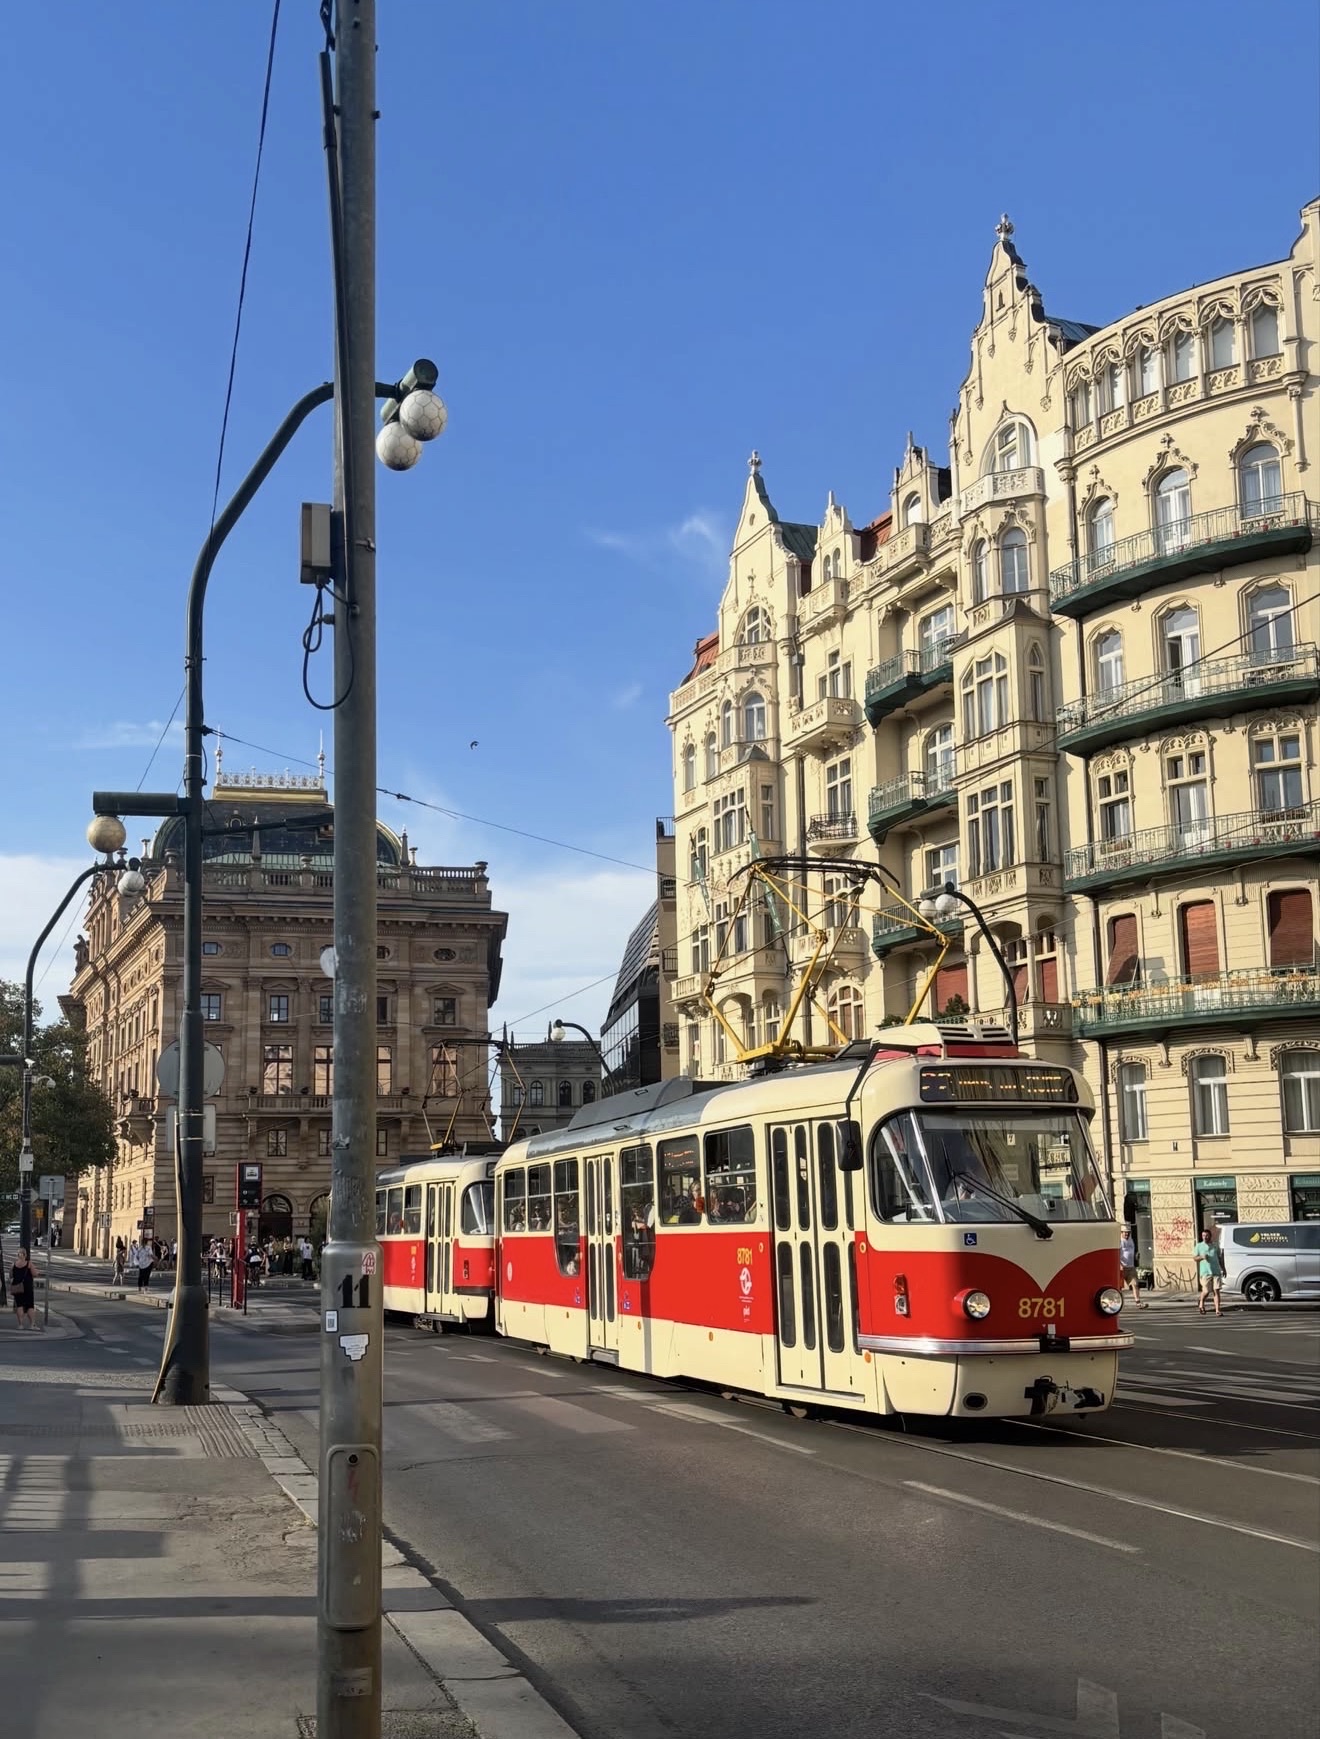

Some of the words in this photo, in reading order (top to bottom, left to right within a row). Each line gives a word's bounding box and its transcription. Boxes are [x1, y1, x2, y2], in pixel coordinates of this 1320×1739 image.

[736, 1247, 753, 1265] 8781
[338, 1274, 371, 1308] 11
[1018, 1297, 1065, 1318] 8781
